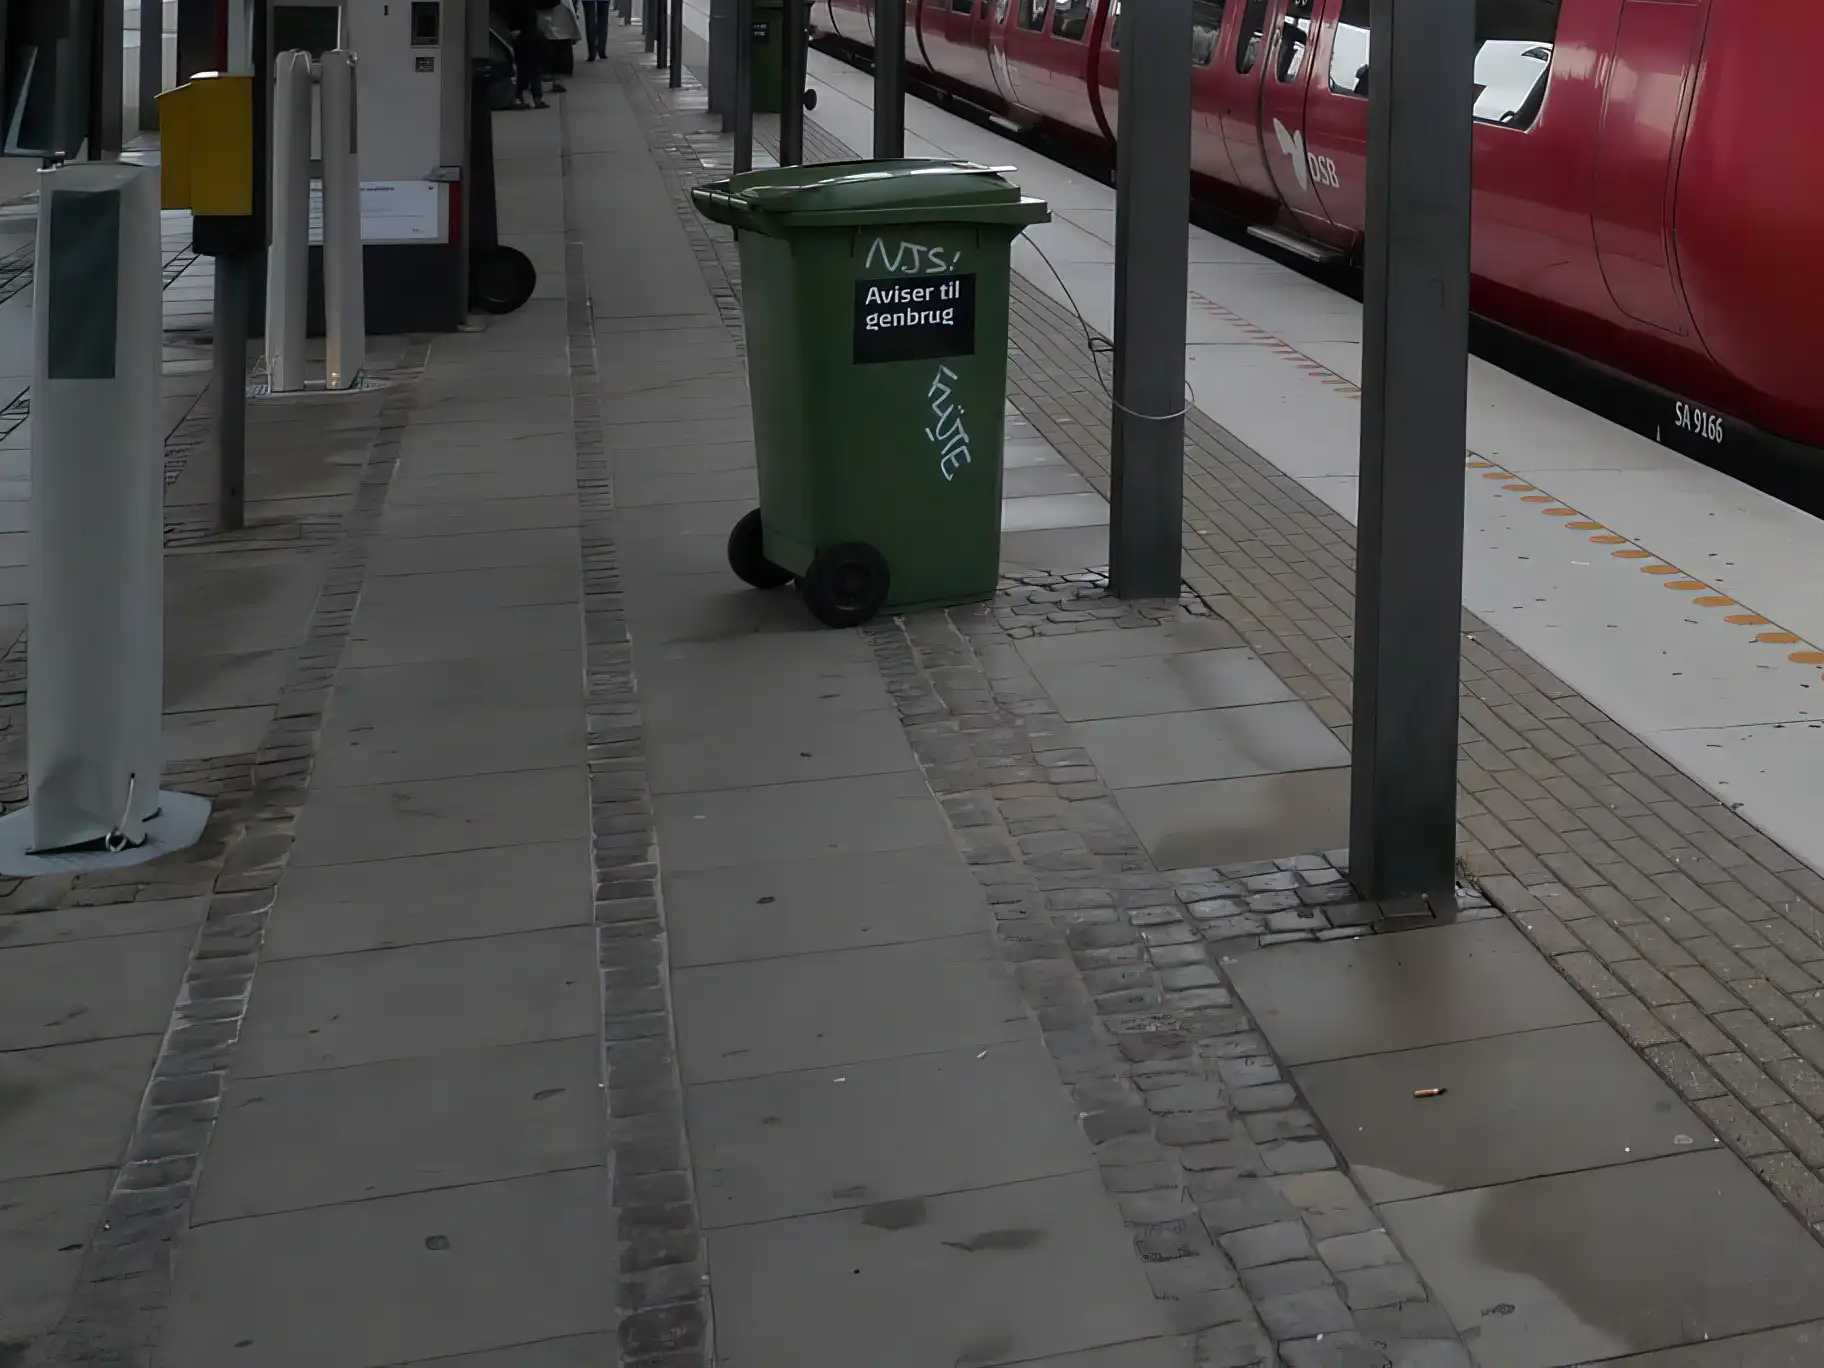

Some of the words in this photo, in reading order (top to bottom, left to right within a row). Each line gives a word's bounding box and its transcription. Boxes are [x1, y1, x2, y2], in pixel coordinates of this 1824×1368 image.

[1307, 152, 1339, 188] DSB
[865, 285, 934, 305] Aviser
[940, 280, 960, 300] til
[866, 307, 954, 331] genbrug
[1675, 400, 1691, 431] SA
[1694, 408, 1723, 443] 9166
